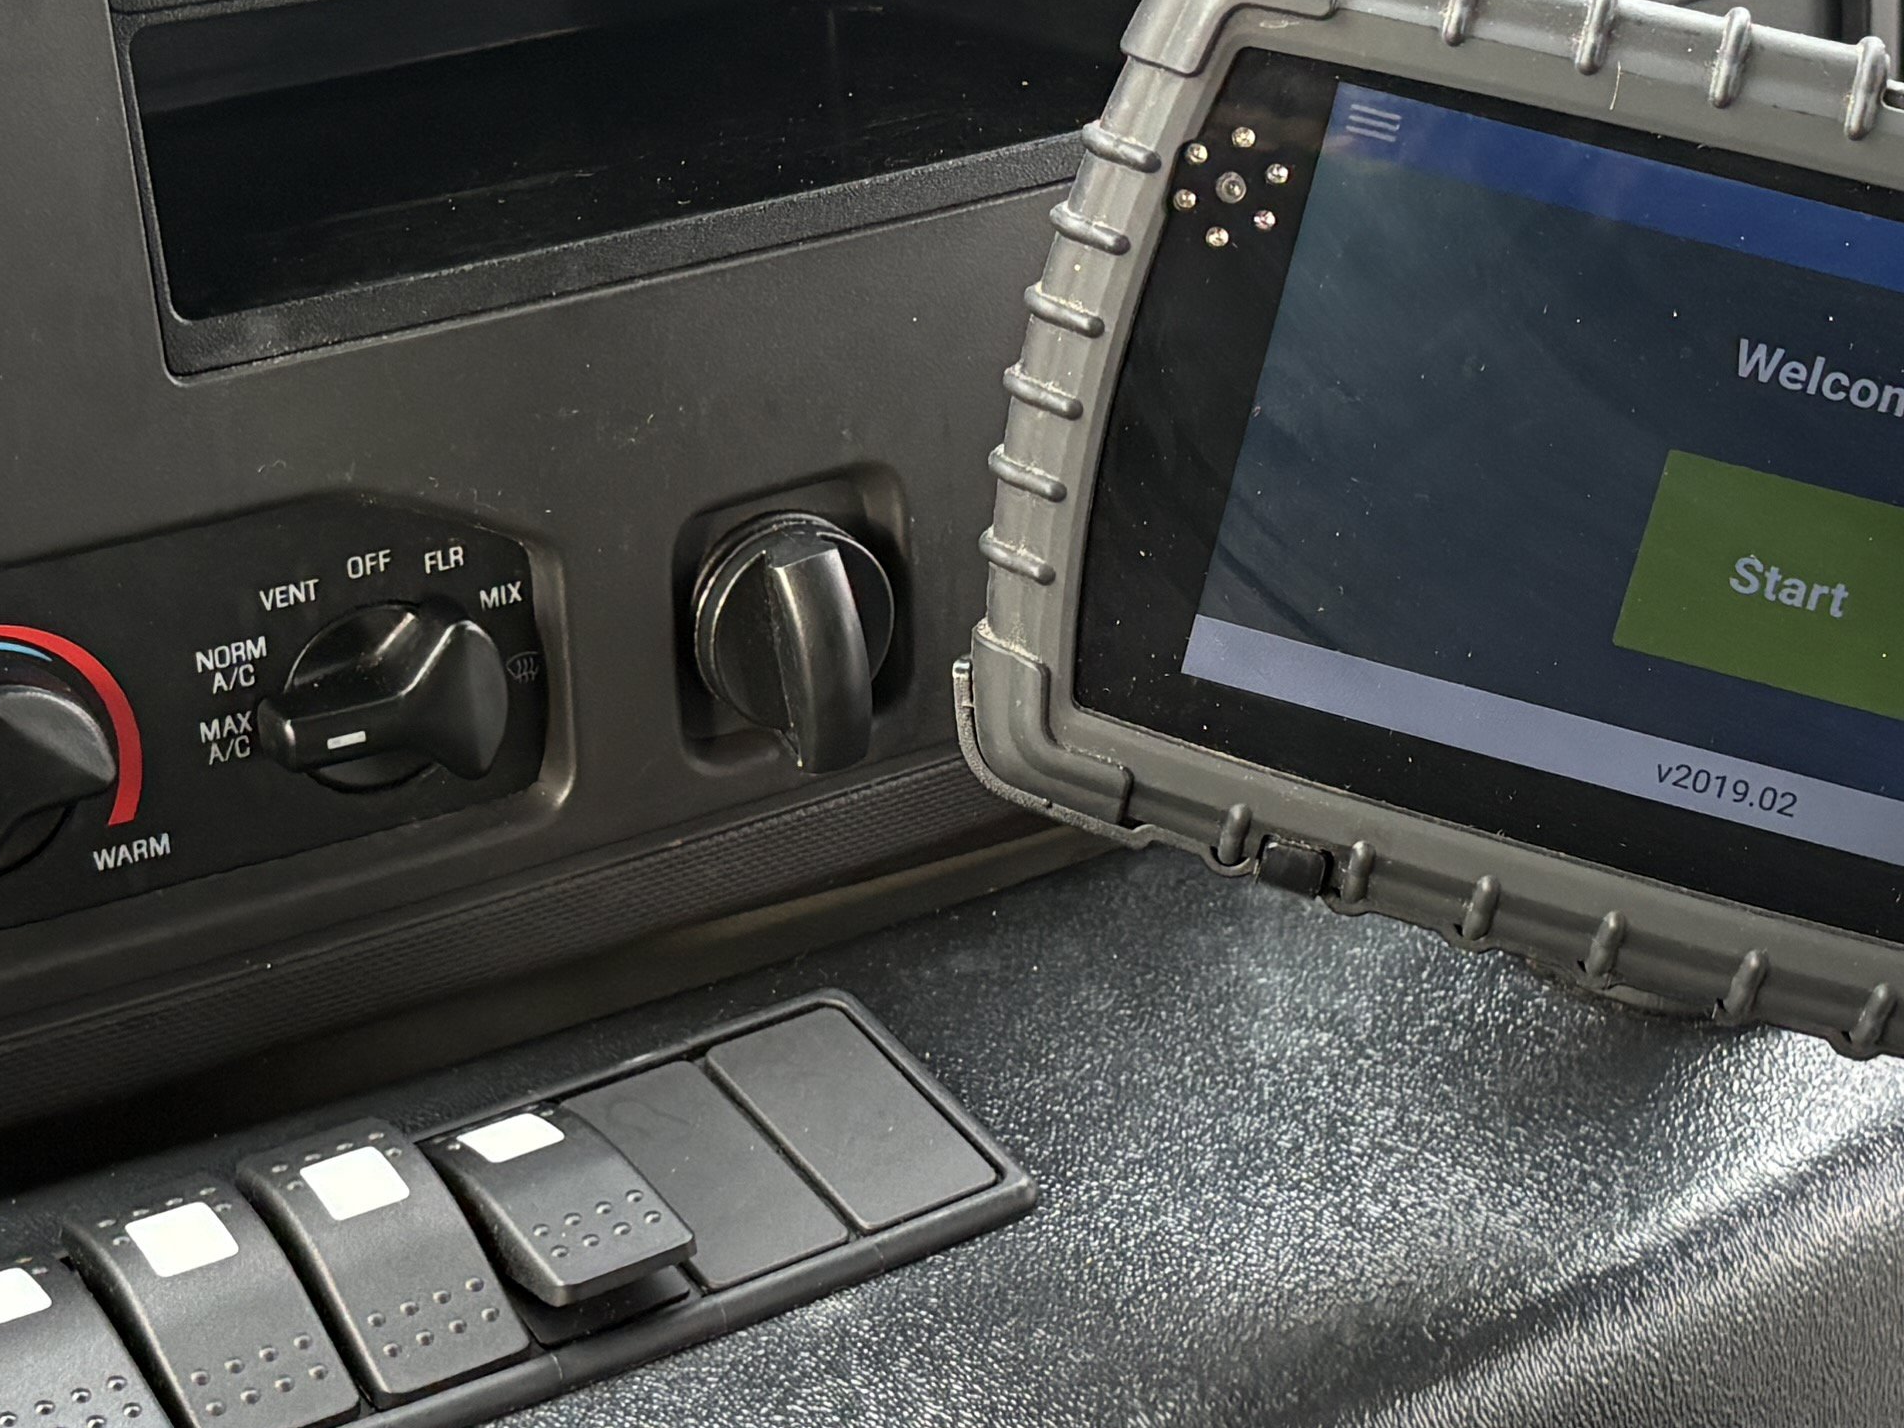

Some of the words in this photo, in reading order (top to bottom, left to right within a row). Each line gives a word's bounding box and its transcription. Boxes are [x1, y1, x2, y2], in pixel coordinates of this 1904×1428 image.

[346, 549, 391, 579] OFF
[424, 546, 464, 574] FLR
[259, 578, 319, 611] VENT
[479, 581, 522, 609] MIX
[1728, 552, 1849, 619] Start
[195, 635, 267, 674] NORM
[212, 661, 256, 694] A/C
[199, 710, 253, 744] MAX
[208, 732, 252, 766] A/C
[1655, 759, 1799, 822] v2019.02
[93, 832, 171, 872] WARM
